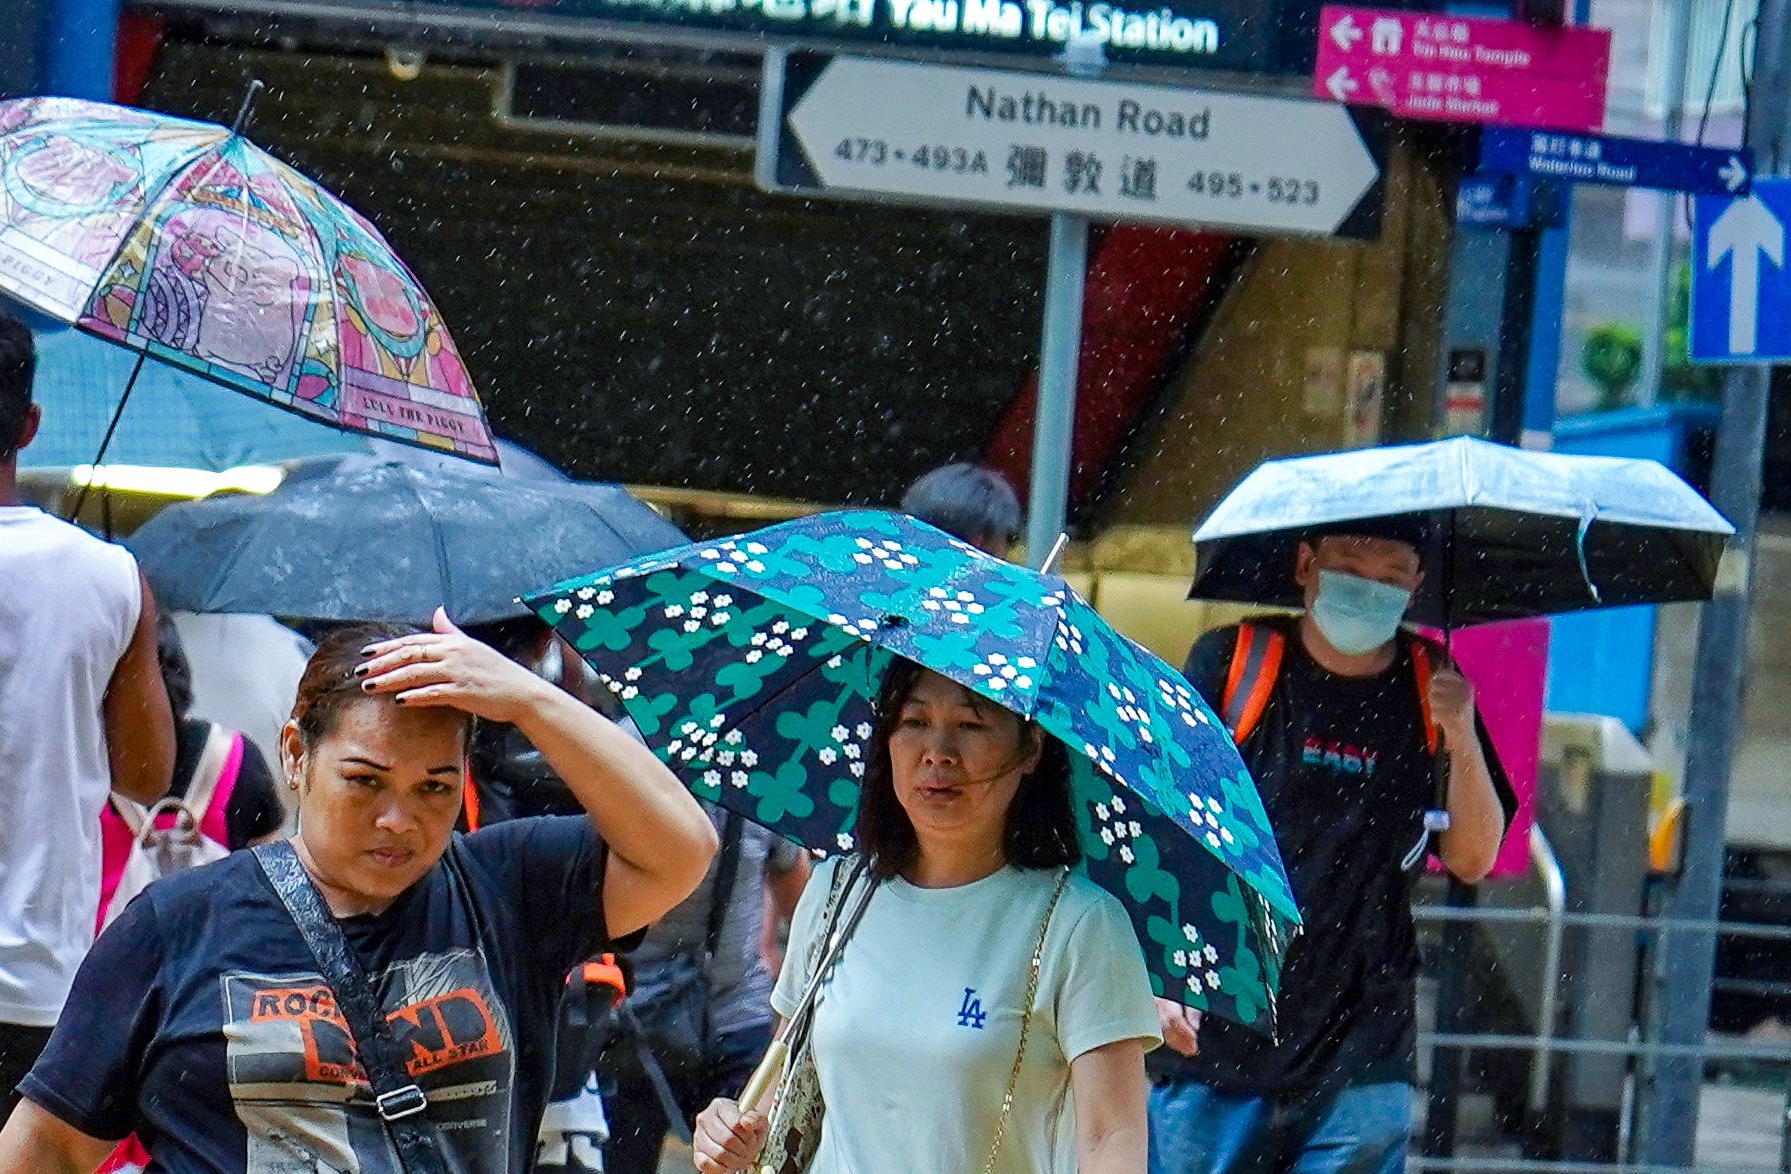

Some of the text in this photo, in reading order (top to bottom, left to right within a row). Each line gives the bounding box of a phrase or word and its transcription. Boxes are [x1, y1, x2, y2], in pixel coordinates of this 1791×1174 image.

[890, 0, 958, 32] Yau
[962, 0, 1023, 38] Ma
[1024, 0, 1085, 41] Tei
[1086, 2, 1221, 55] Station
[965, 83, 1211, 142] Nathan Road
[1006, 141, 1158, 201] 彌敦道
[957, 986, 987, 1030] LA
